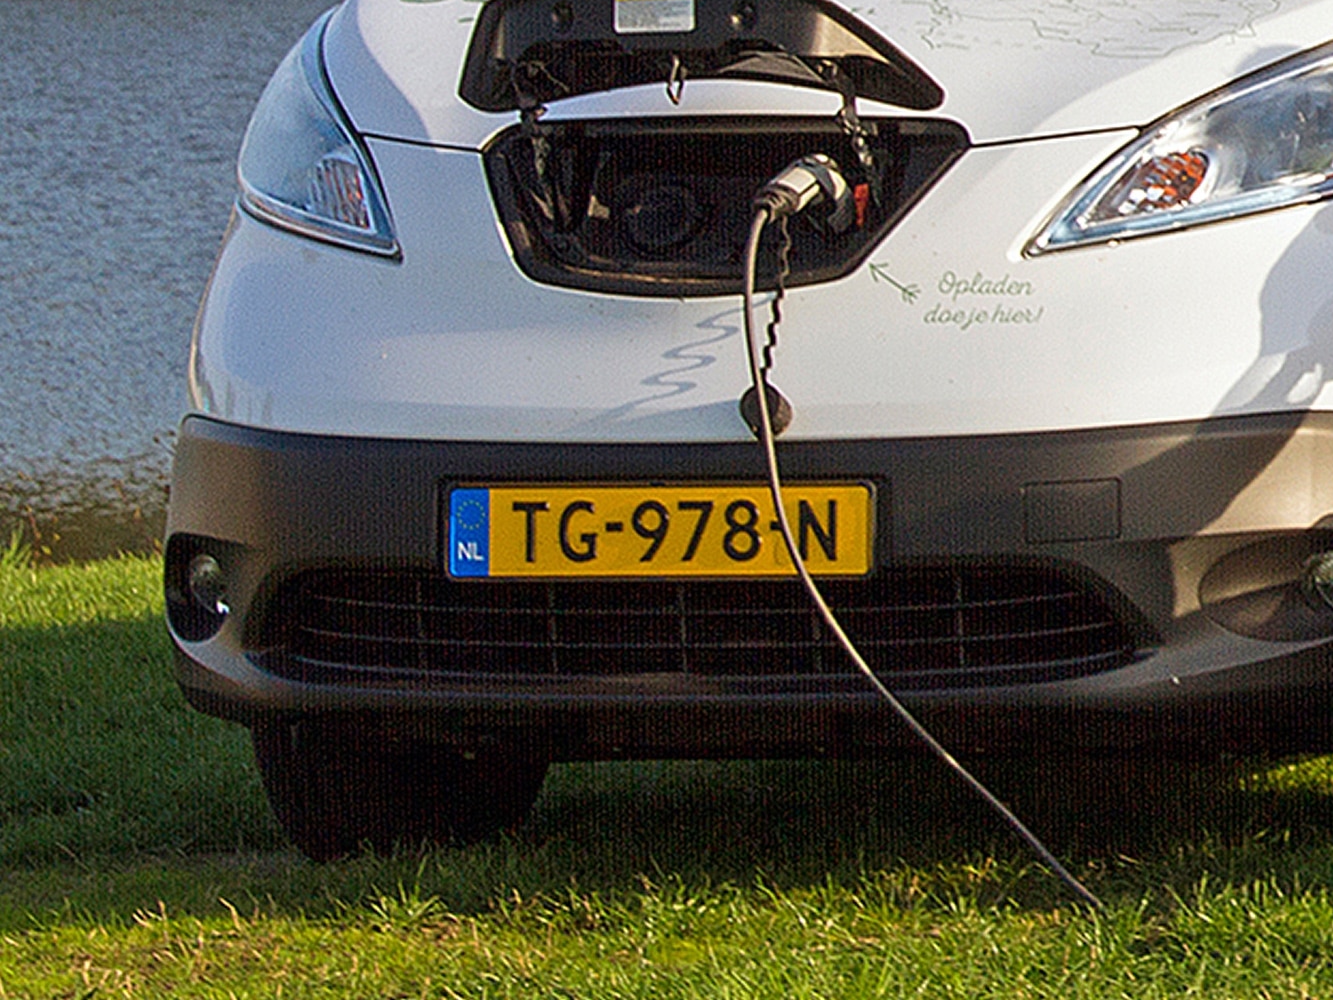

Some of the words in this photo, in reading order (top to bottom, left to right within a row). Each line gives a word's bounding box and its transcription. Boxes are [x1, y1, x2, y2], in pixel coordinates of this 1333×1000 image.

[938, 270, 1035, 302] Opladen
[512, 499, 838, 563] TG-978-N
[457, 542, 484, 561] NL
